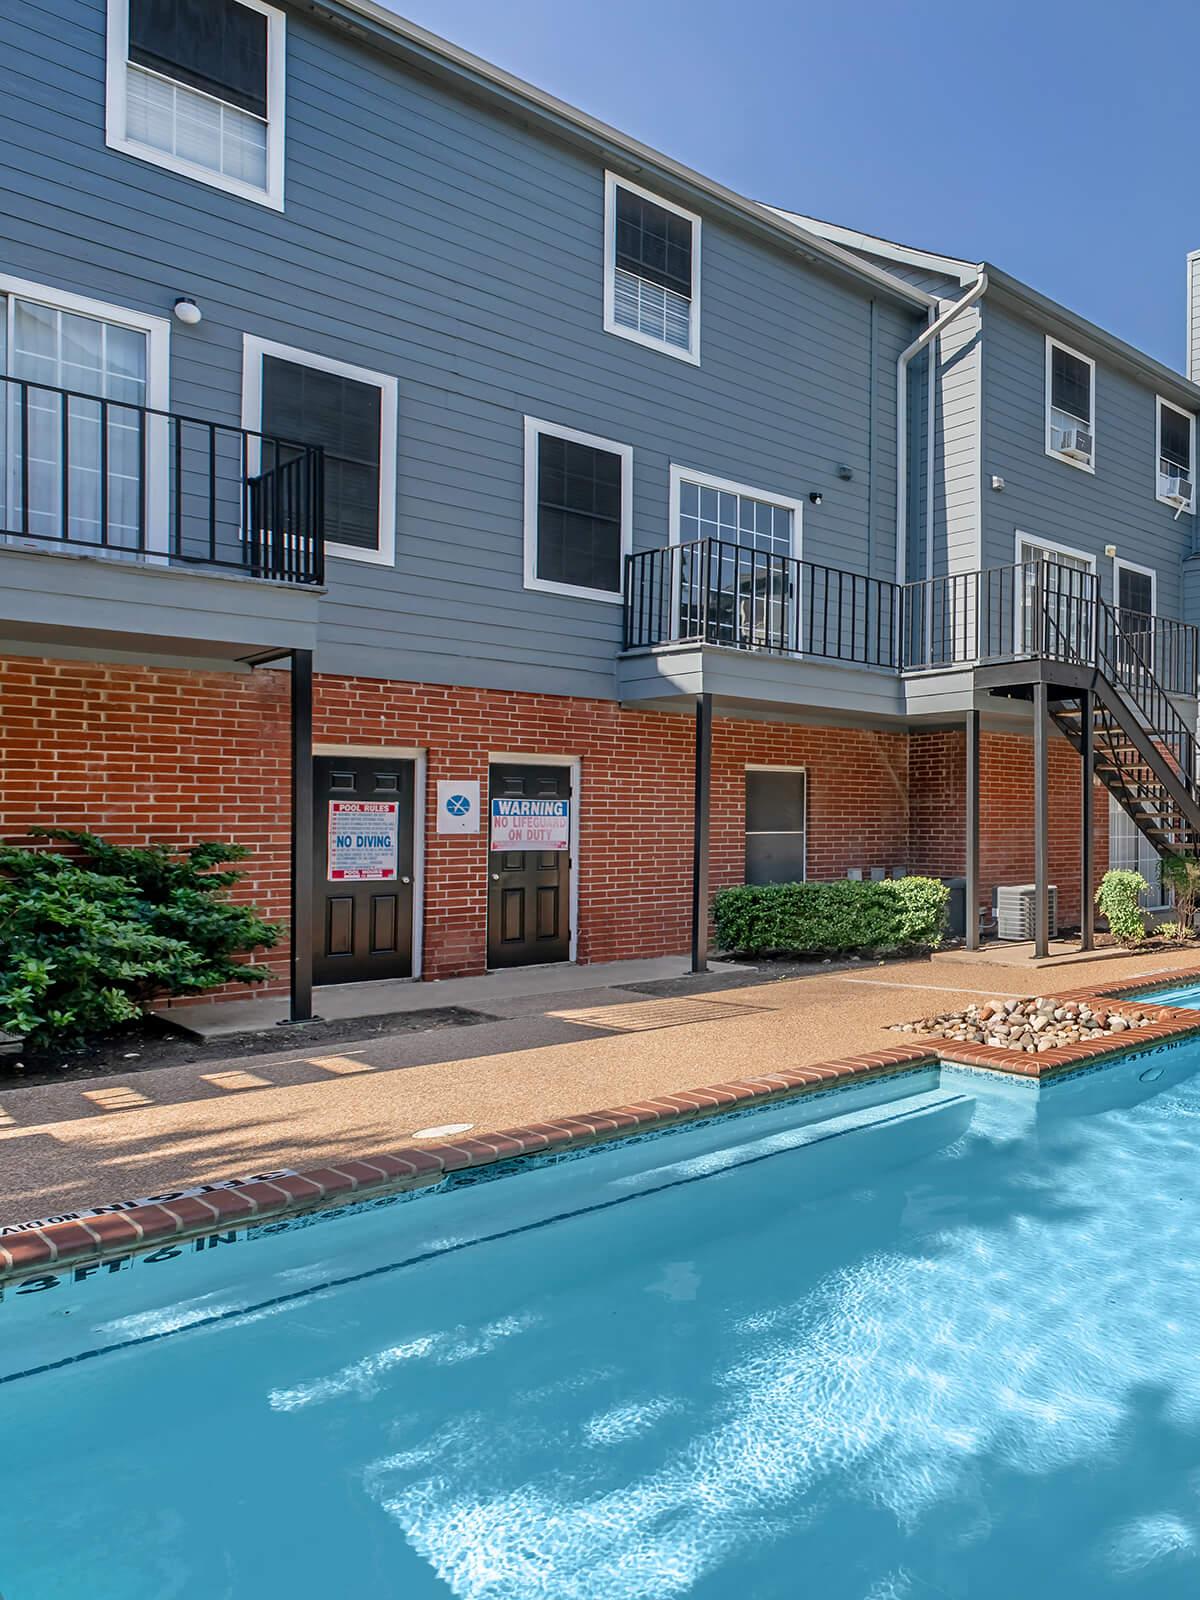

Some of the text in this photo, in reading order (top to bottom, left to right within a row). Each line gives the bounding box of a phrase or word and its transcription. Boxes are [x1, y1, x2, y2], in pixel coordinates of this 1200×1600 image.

[338, 804, 390, 812] POOL RULES
[498, 800, 563, 816] WARNING
[494, 816, 508, 829] NO
[336, 835, 352, 848] NO
[508, 829, 553, 841] ON DUTY
[250, 1170, 288, 1181] 3
[201, 1179, 247, 1194] FT
[147, 1192, 185, 1203] 6
[92, 1201, 140, 1216] IN
[47, 1212, 80, 1225] NO
[16, 1274, 61, 1295] 3
[143, 1244, 182, 1264] 6
